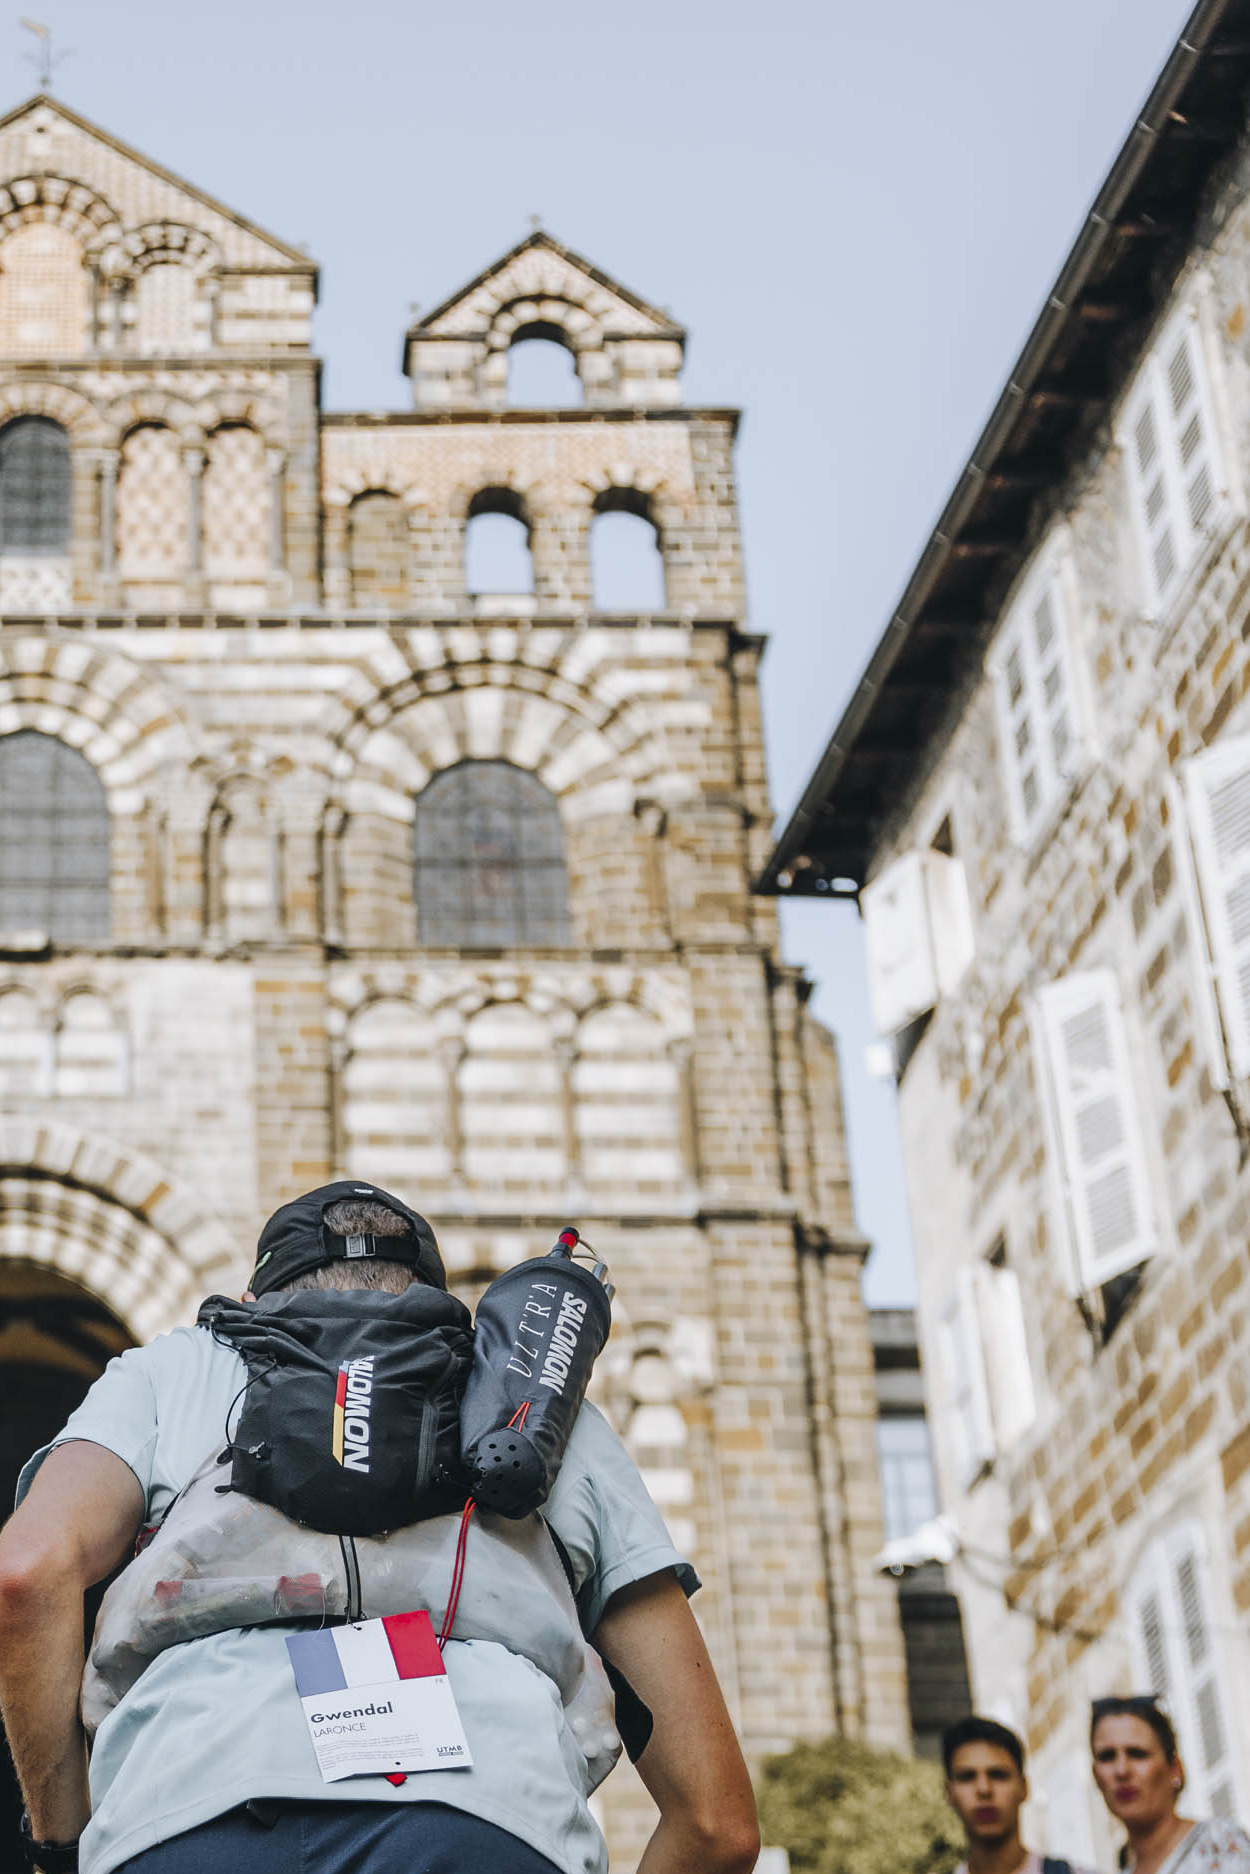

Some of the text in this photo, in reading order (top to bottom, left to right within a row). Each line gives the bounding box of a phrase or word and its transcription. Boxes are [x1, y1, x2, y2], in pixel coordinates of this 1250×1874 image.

[538, 1291, 588, 1396] SALOMON
[310, 1701, 394, 1723] Gwendal
[313, 1723, 367, 1738] LARONCE
